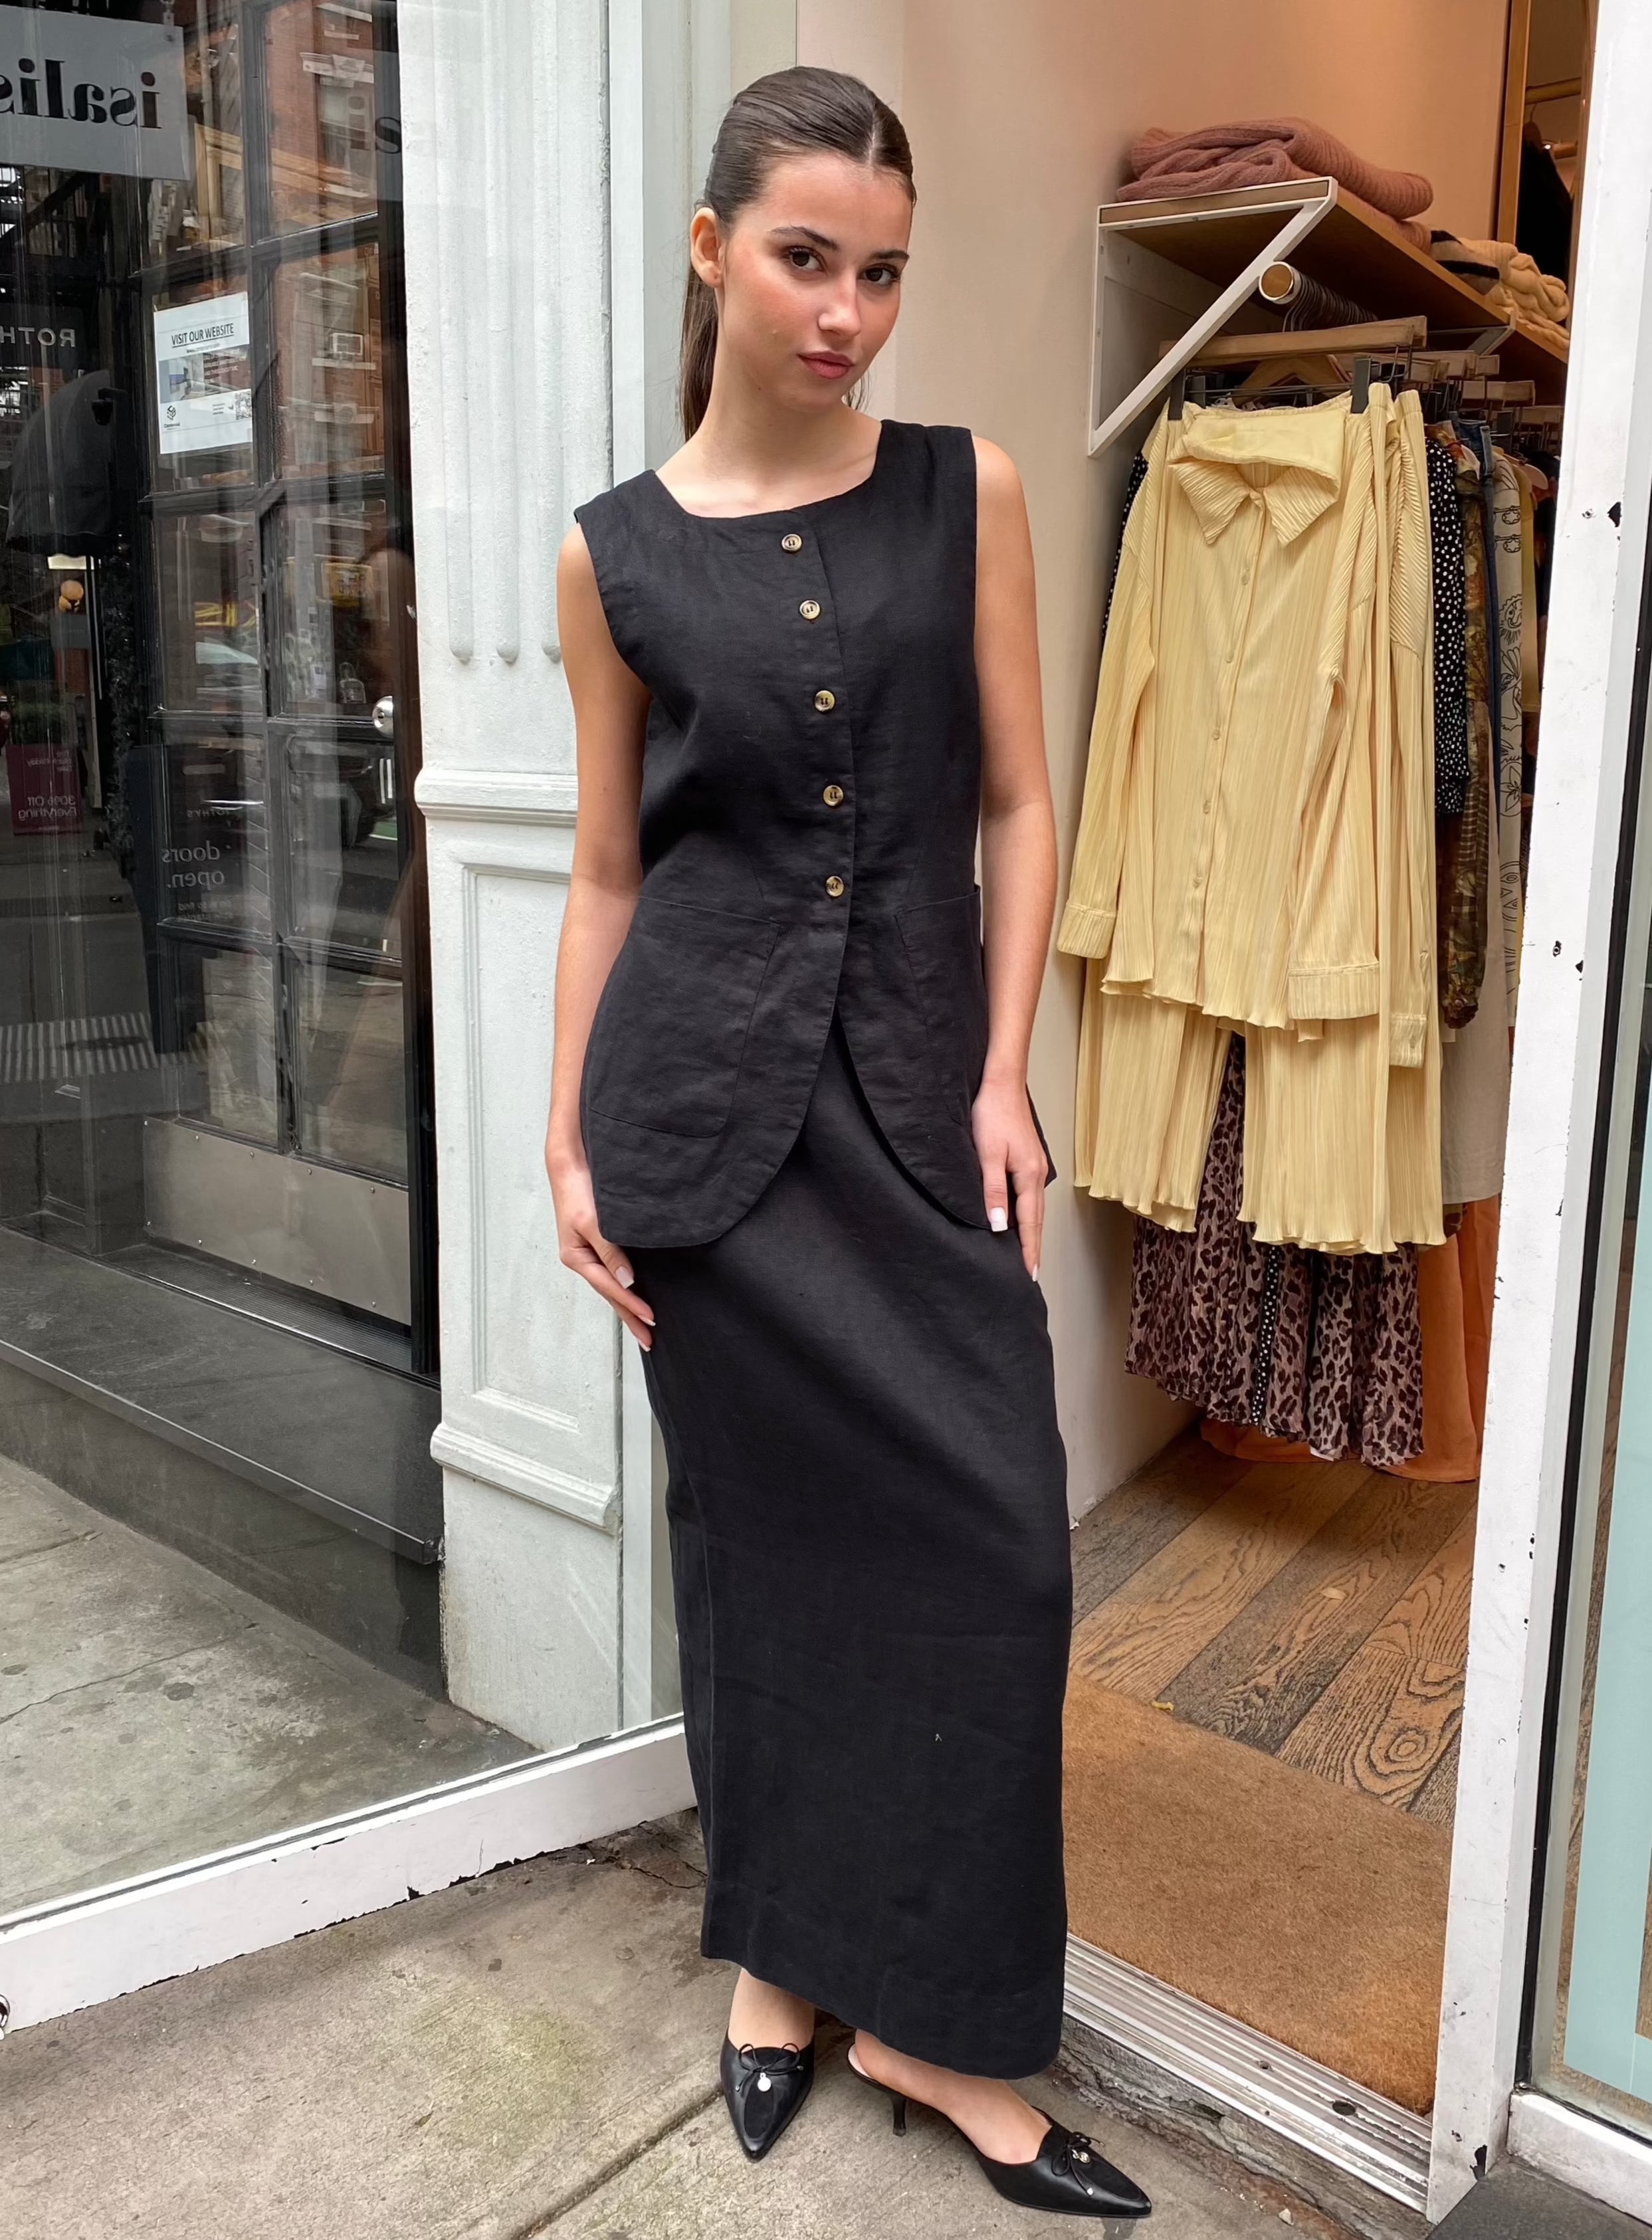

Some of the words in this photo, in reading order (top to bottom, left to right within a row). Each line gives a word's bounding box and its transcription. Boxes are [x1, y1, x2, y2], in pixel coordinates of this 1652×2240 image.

[171, 333, 188, 346] VISIT
[189, 329, 204, 342] OUR
[205, 323, 234, 338] WEBSITE
